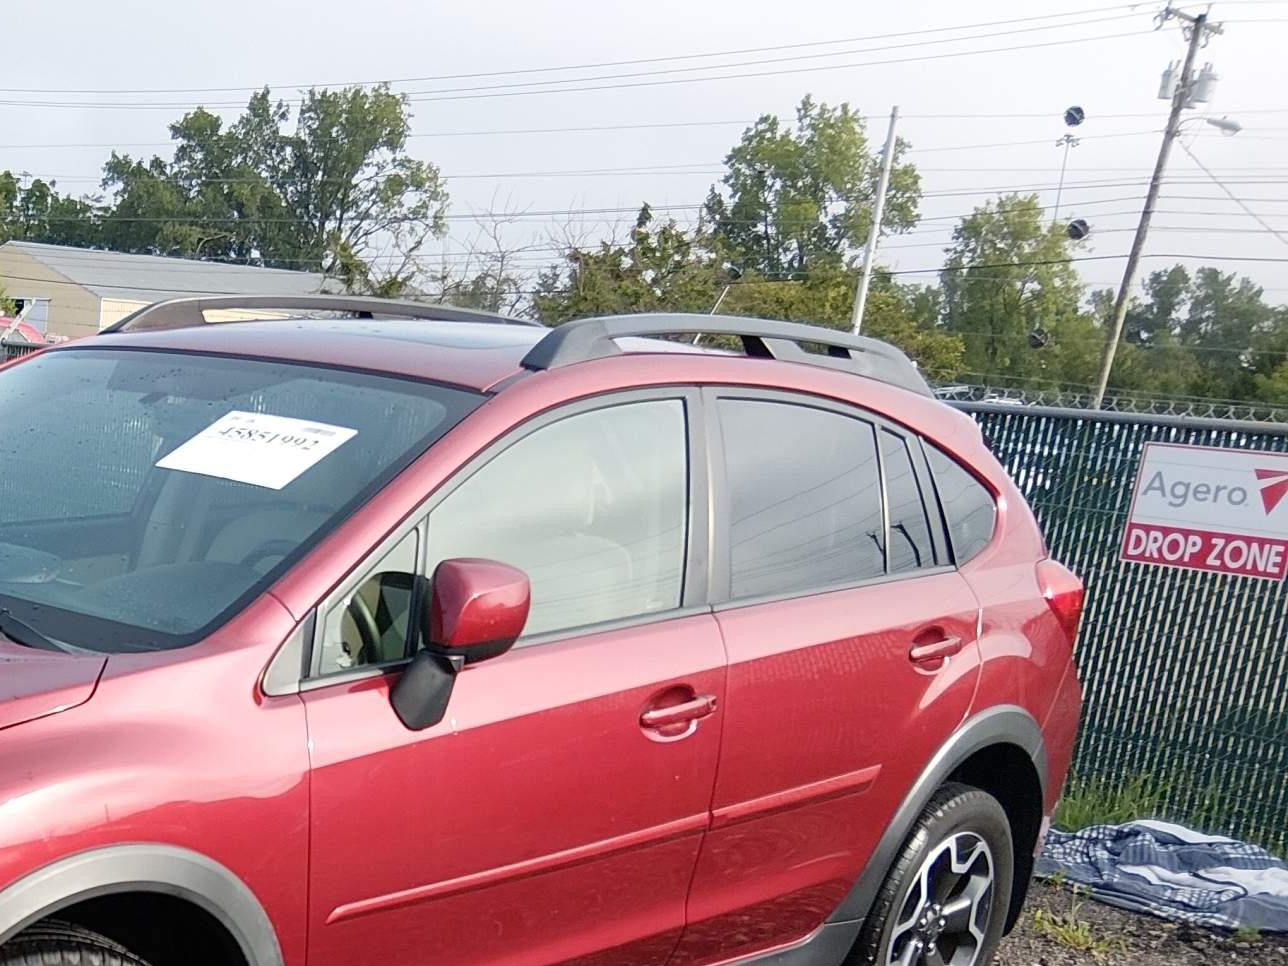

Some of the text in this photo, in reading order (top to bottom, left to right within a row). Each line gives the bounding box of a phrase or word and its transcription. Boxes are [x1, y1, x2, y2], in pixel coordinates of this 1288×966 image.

[1142, 470, 1248, 508] Agero
[1126, 528, 1285, 573] DROP ZONE
